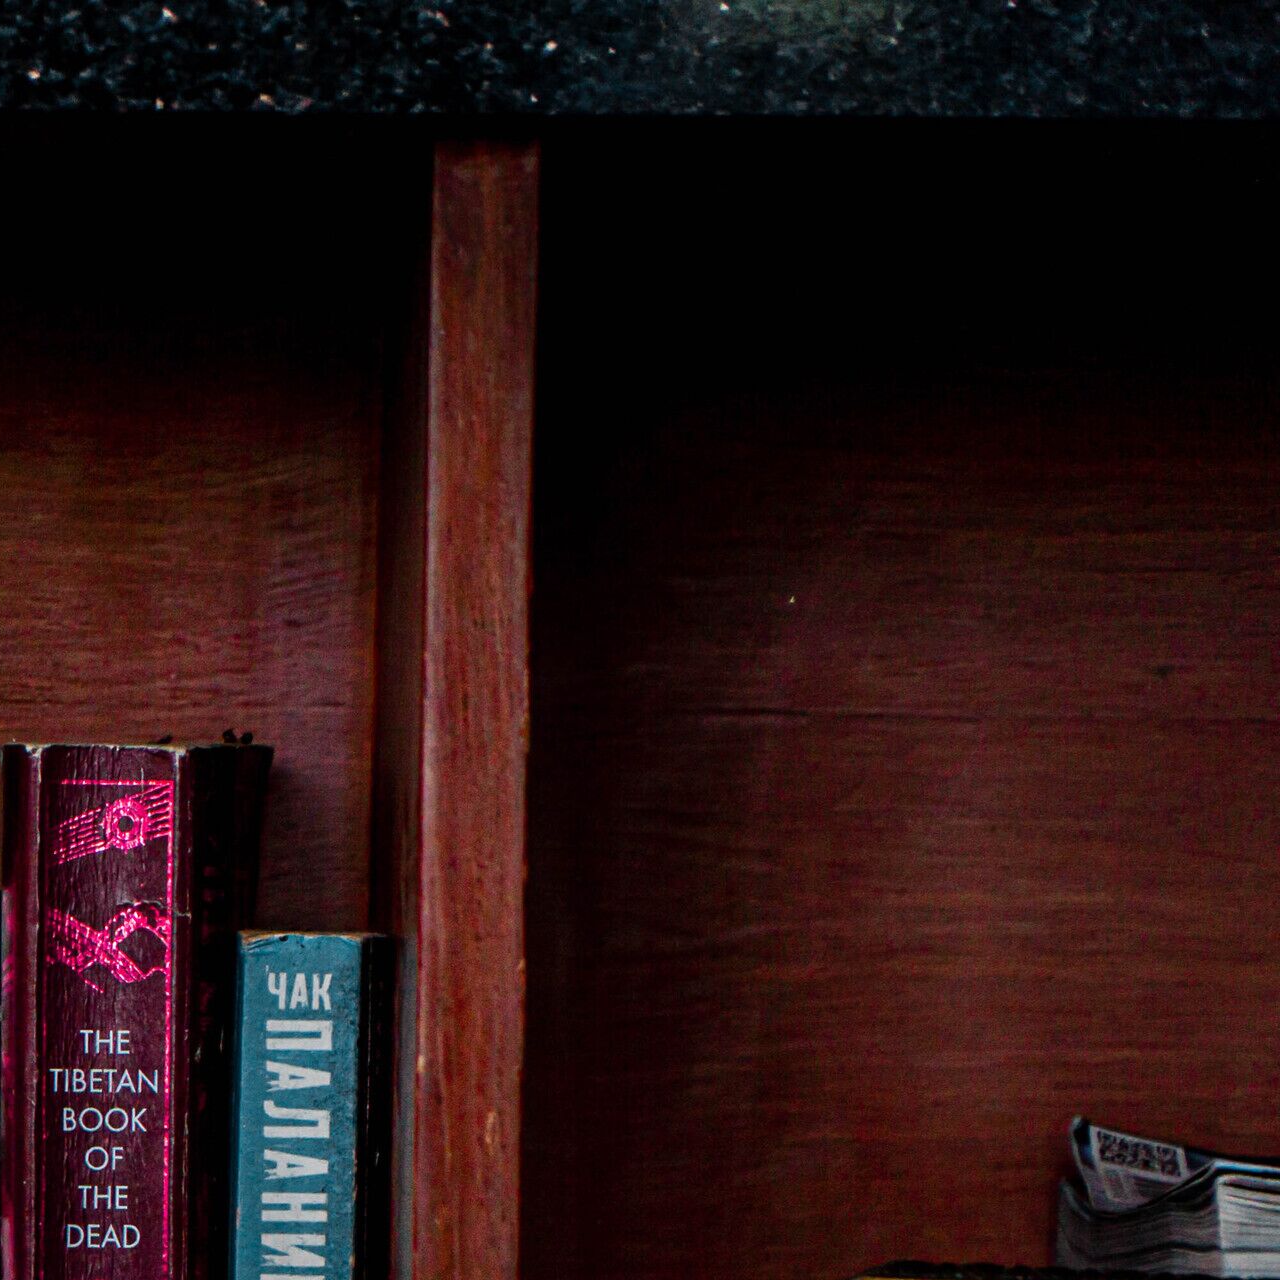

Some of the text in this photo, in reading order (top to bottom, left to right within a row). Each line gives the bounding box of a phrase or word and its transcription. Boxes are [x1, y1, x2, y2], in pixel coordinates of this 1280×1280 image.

[266, 965, 332, 1011] ЧАК
[80, 1028, 131, 1055] THE
[49, 1067, 159, 1095] TIBETAN
[62, 1107, 148, 1134] BOOK
[84, 1145, 124, 1172] OF
[78, 1185, 129, 1211] THE
[66, 1224, 141, 1250] DEAD
